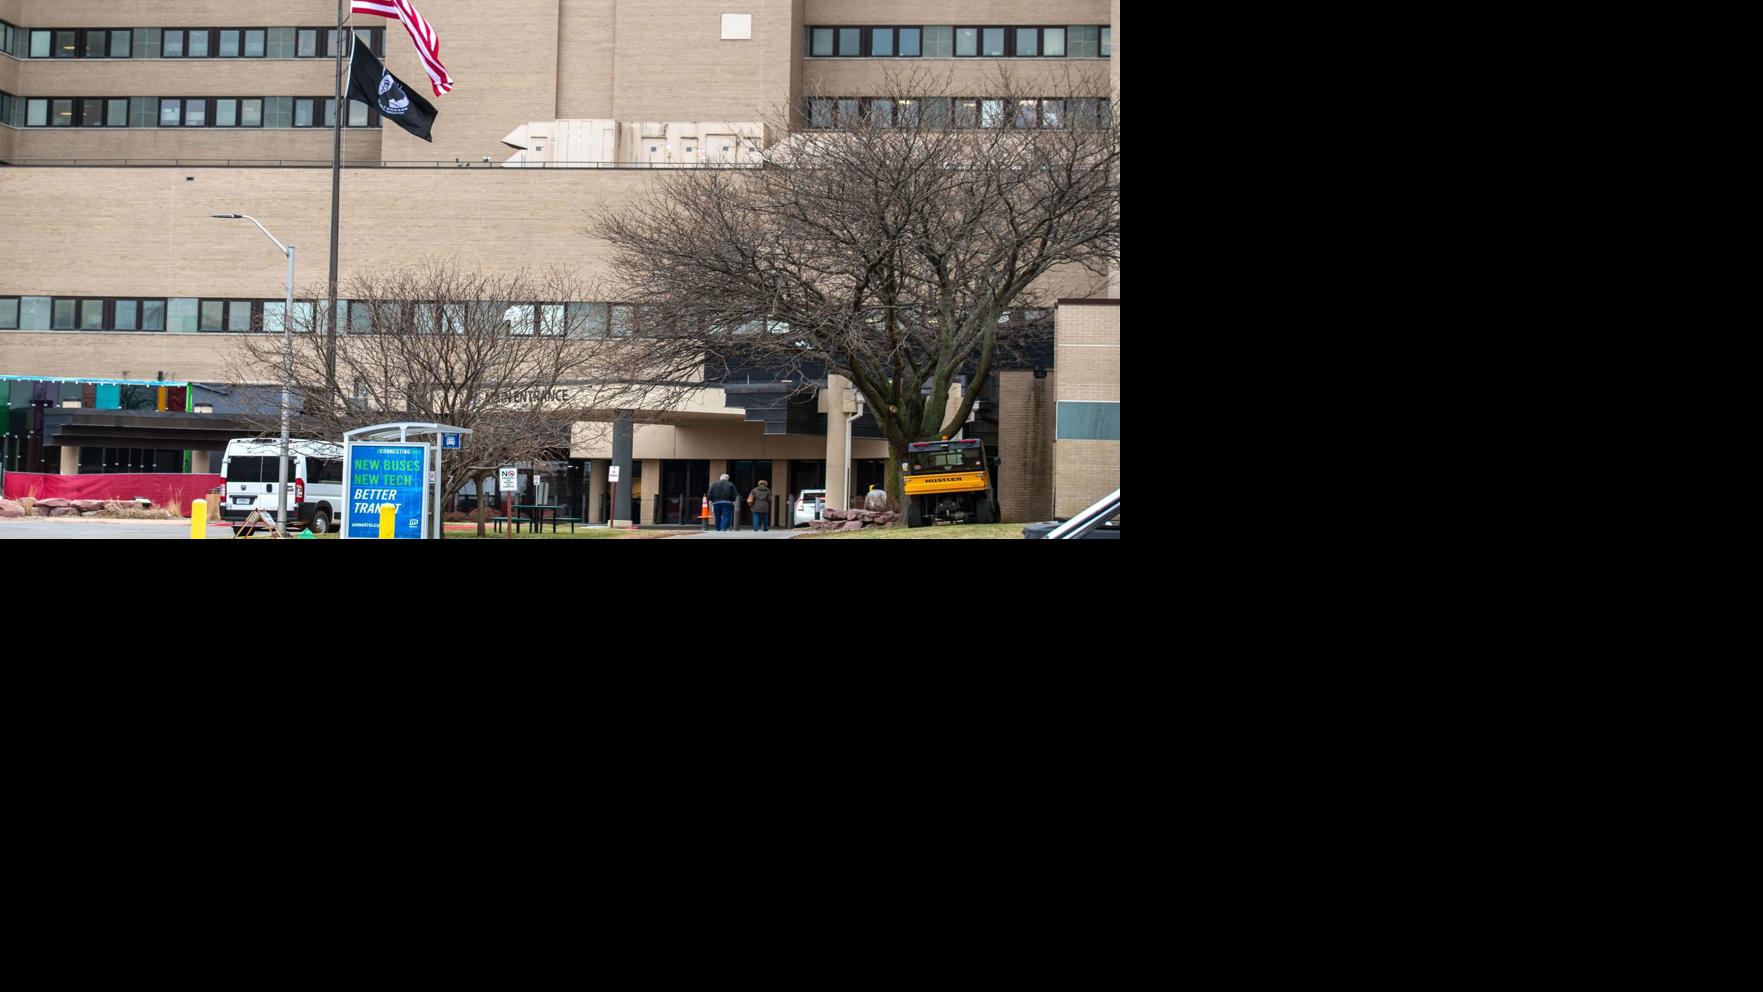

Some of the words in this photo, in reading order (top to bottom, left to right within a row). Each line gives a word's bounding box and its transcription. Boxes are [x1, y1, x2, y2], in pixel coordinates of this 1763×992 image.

[515, 389, 569, 402] ENTRANCE
[355, 459, 380, 470] NEW
[384, 460, 420, 471] BUSES
[354, 474, 379, 485] NEW
[384, 474, 412, 486] TECH
[354, 488, 397, 500] BETTER
[354, 502, 401, 514] TRANT
